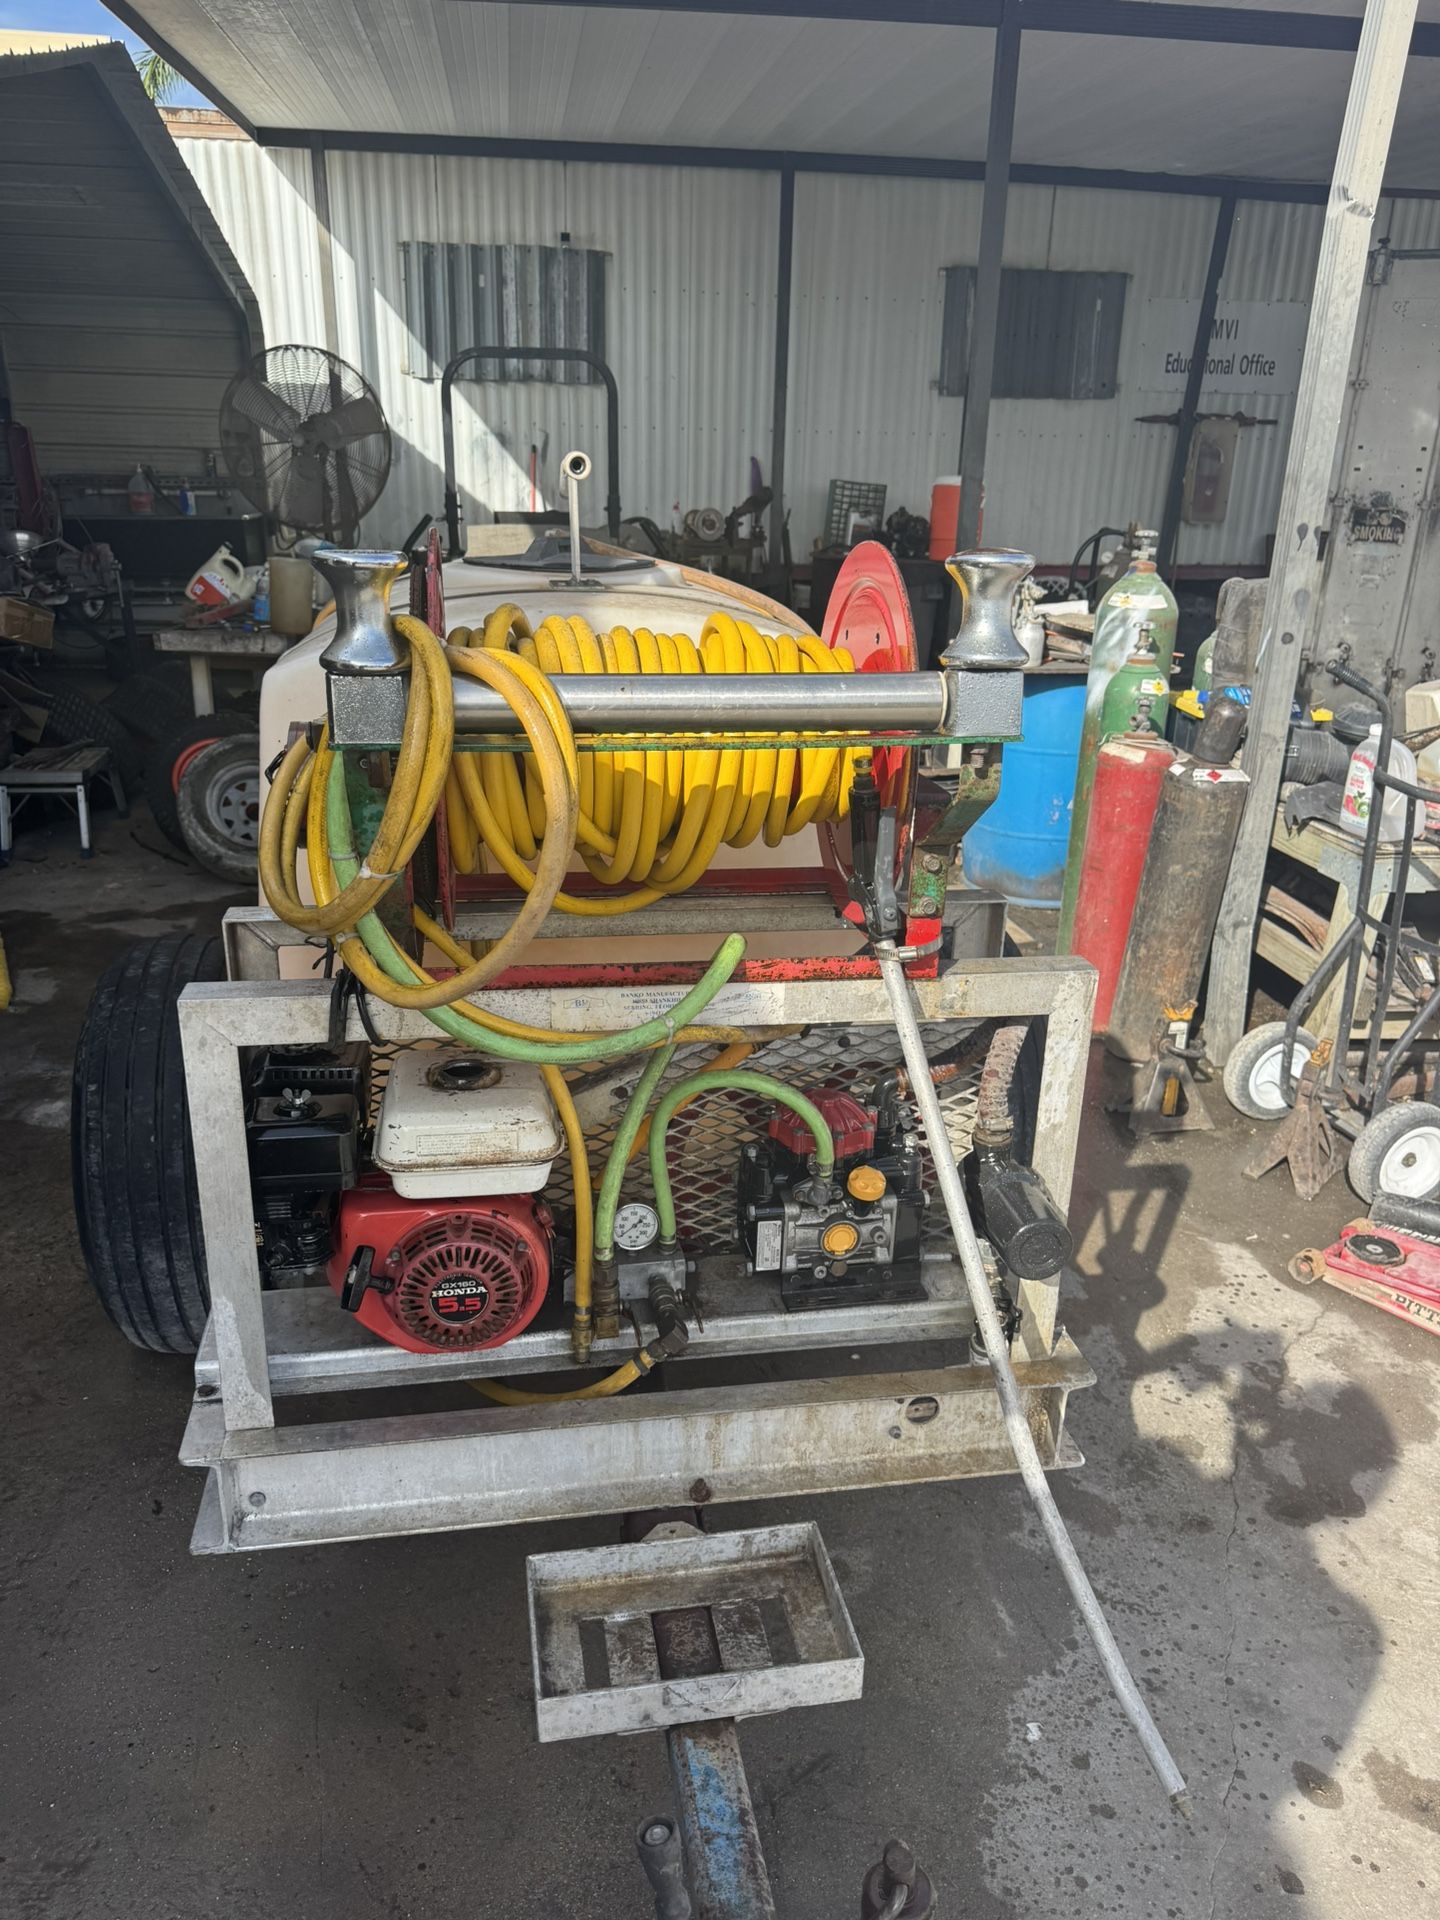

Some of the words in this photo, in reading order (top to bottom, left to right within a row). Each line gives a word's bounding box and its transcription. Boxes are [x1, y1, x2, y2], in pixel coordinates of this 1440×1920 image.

[1240, 353, 1276, 376] Office
[431, 1286, 488, 1298] HONDA
[441, 1280, 476, 1289] GX160
[438, 1296, 481, 1313] 5.5
[1394, 1293, 1440, 1324] PITT
